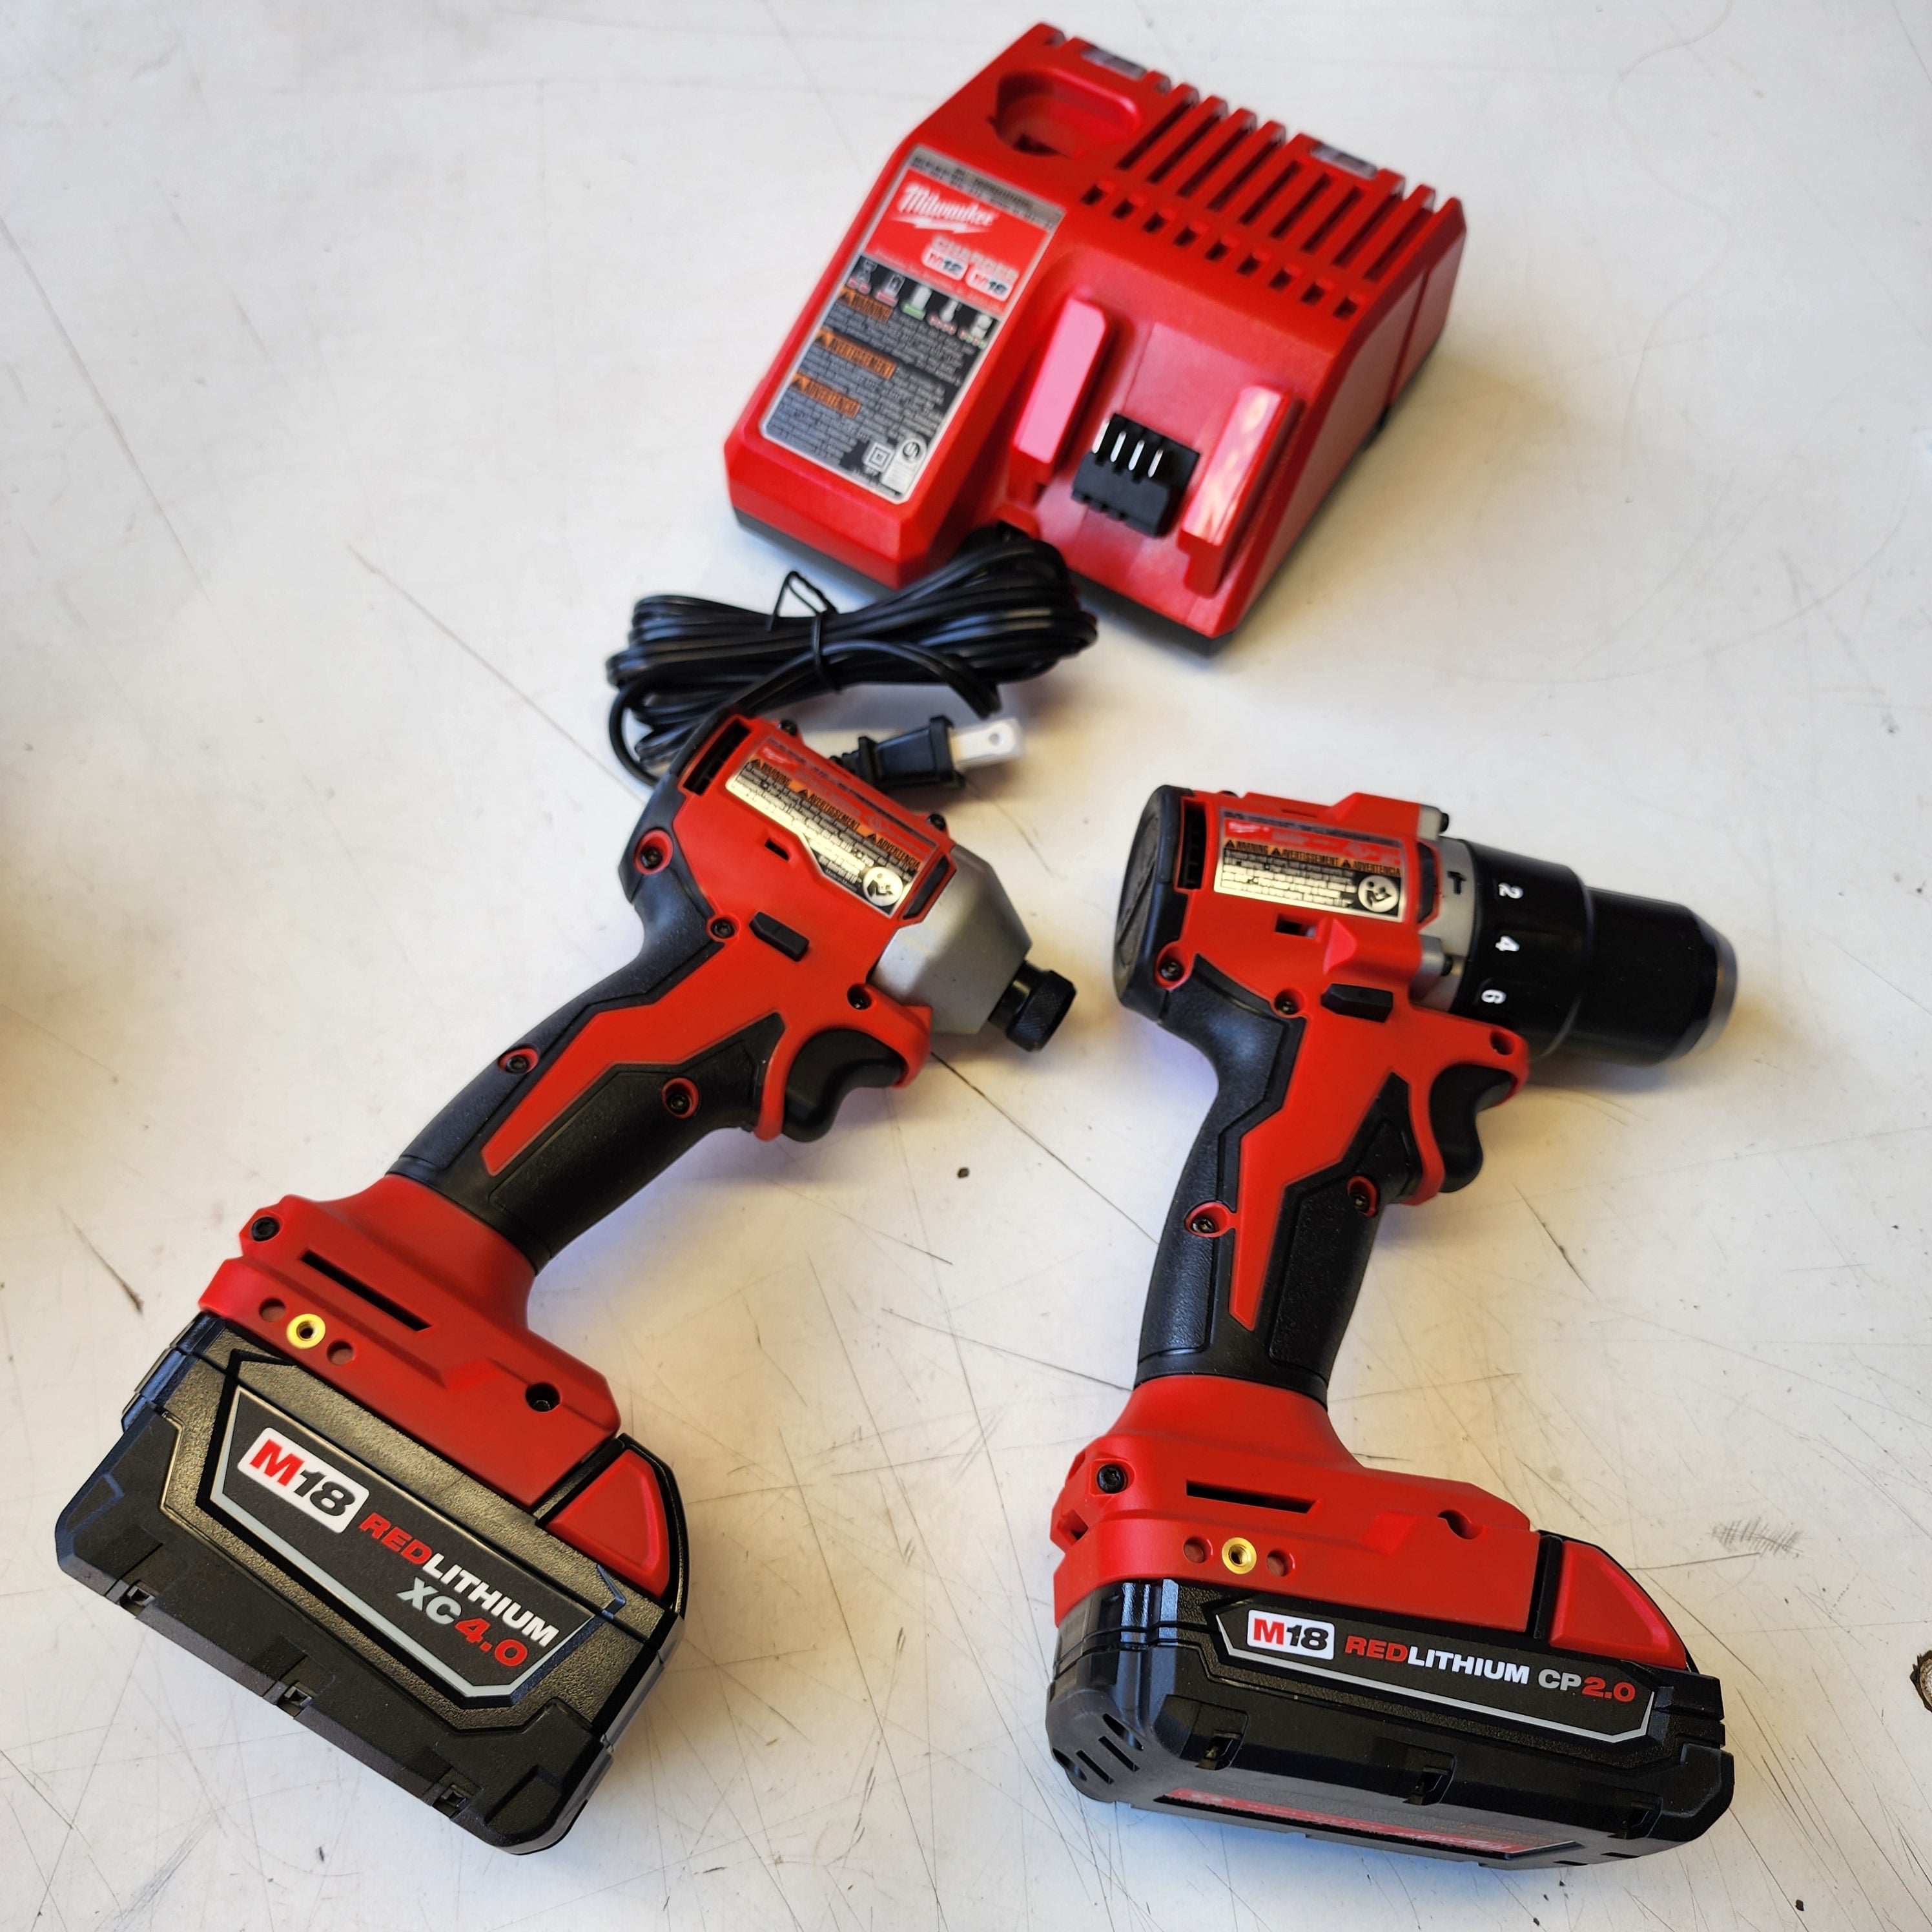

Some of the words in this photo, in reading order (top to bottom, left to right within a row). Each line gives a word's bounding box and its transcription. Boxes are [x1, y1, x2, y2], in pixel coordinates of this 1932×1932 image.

[877, 838, 921, 870] ADVERTENCIA
[1498, 882, 1524, 899] 2
[1495, 935, 1520, 952] 4
[1481, 989, 1506, 1005] 6
[249, 1438, 356, 1517] M18
[358, 1512, 560, 1648] REDLITHIUM
[1253, 1619, 1329, 1651] M18
[1344, 1636, 1530, 1685] REDLITHIUM
